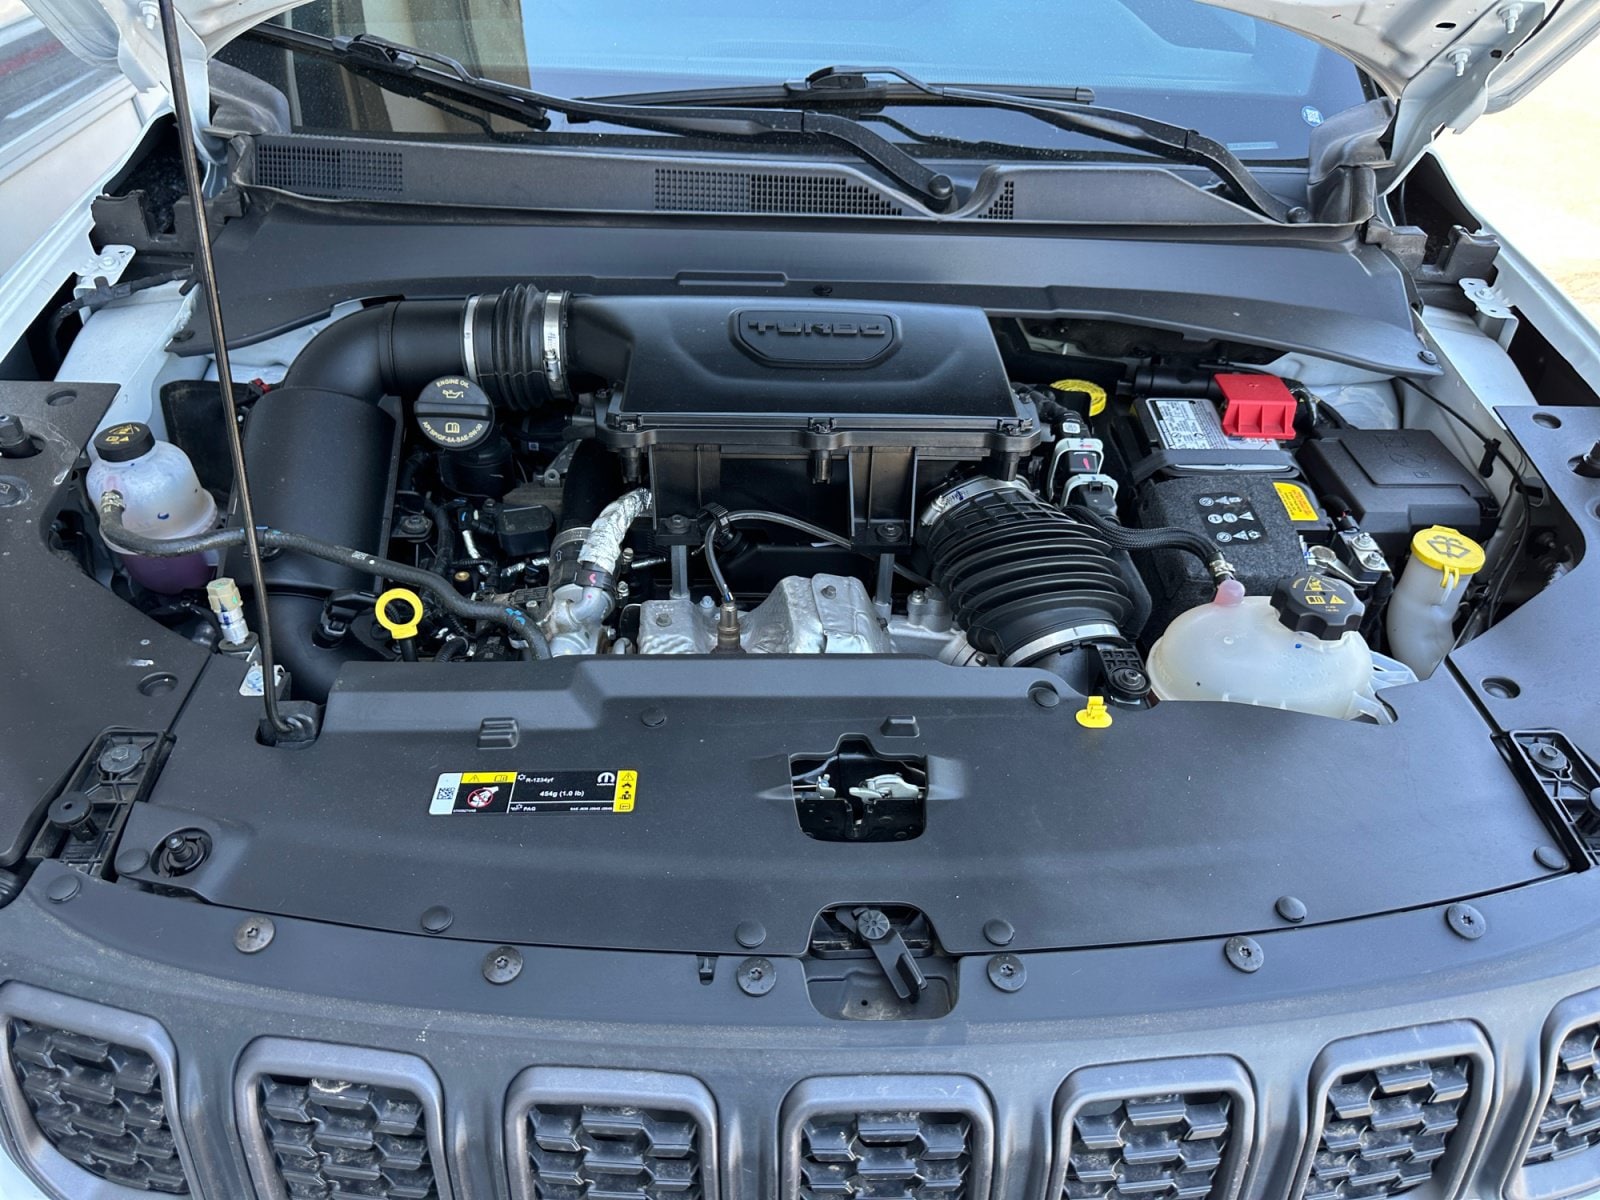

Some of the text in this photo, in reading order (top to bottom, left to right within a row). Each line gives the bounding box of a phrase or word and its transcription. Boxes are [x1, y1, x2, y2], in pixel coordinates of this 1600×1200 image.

[748, 319, 886, 336] TURBO
[436, 379, 470, 389] ENGINE OIL
[539, 790, 585, 798] 454g (1.0 lb)
